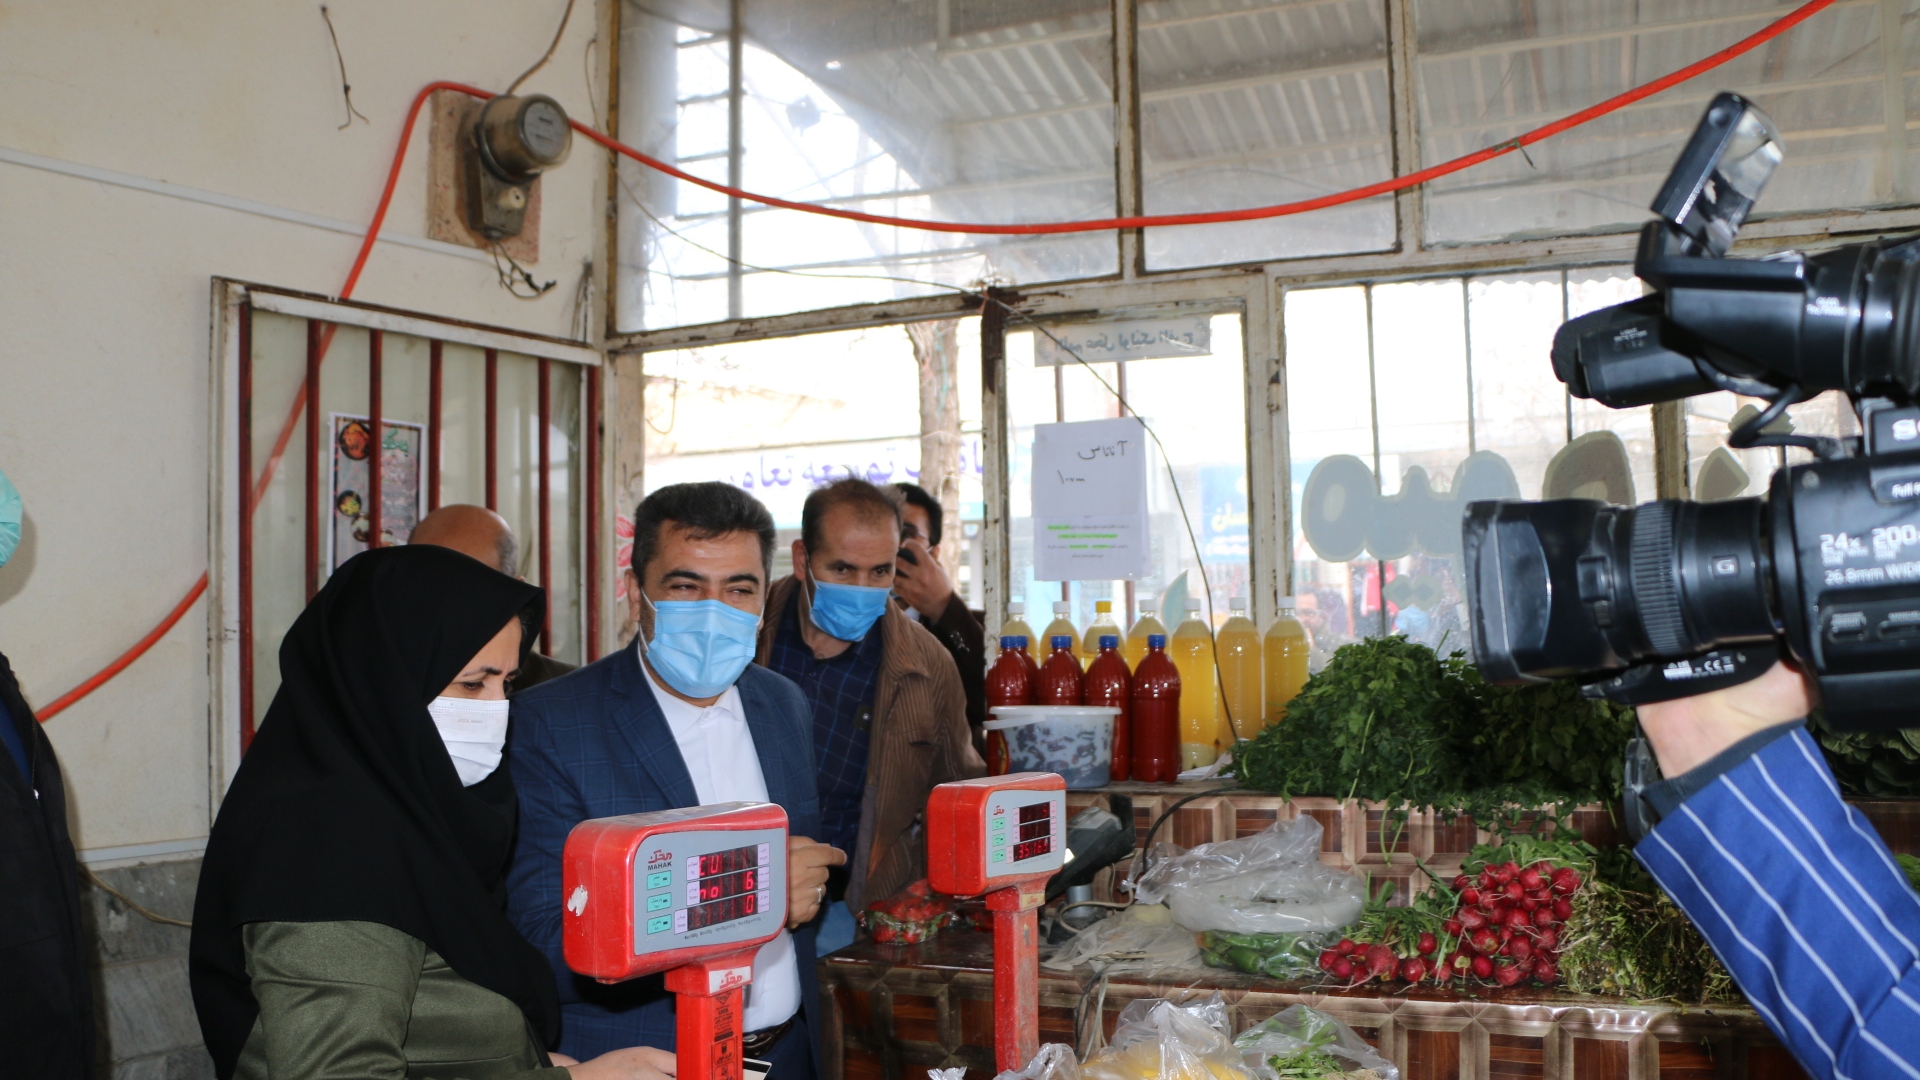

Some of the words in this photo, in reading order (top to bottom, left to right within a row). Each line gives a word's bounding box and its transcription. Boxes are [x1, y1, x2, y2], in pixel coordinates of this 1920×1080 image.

[1892, 418, 1920, 441] S
[1716, 559, 1735, 576] G
[648, 861, 672, 871] MAHAK
[719, 970, 743, 990] محک
